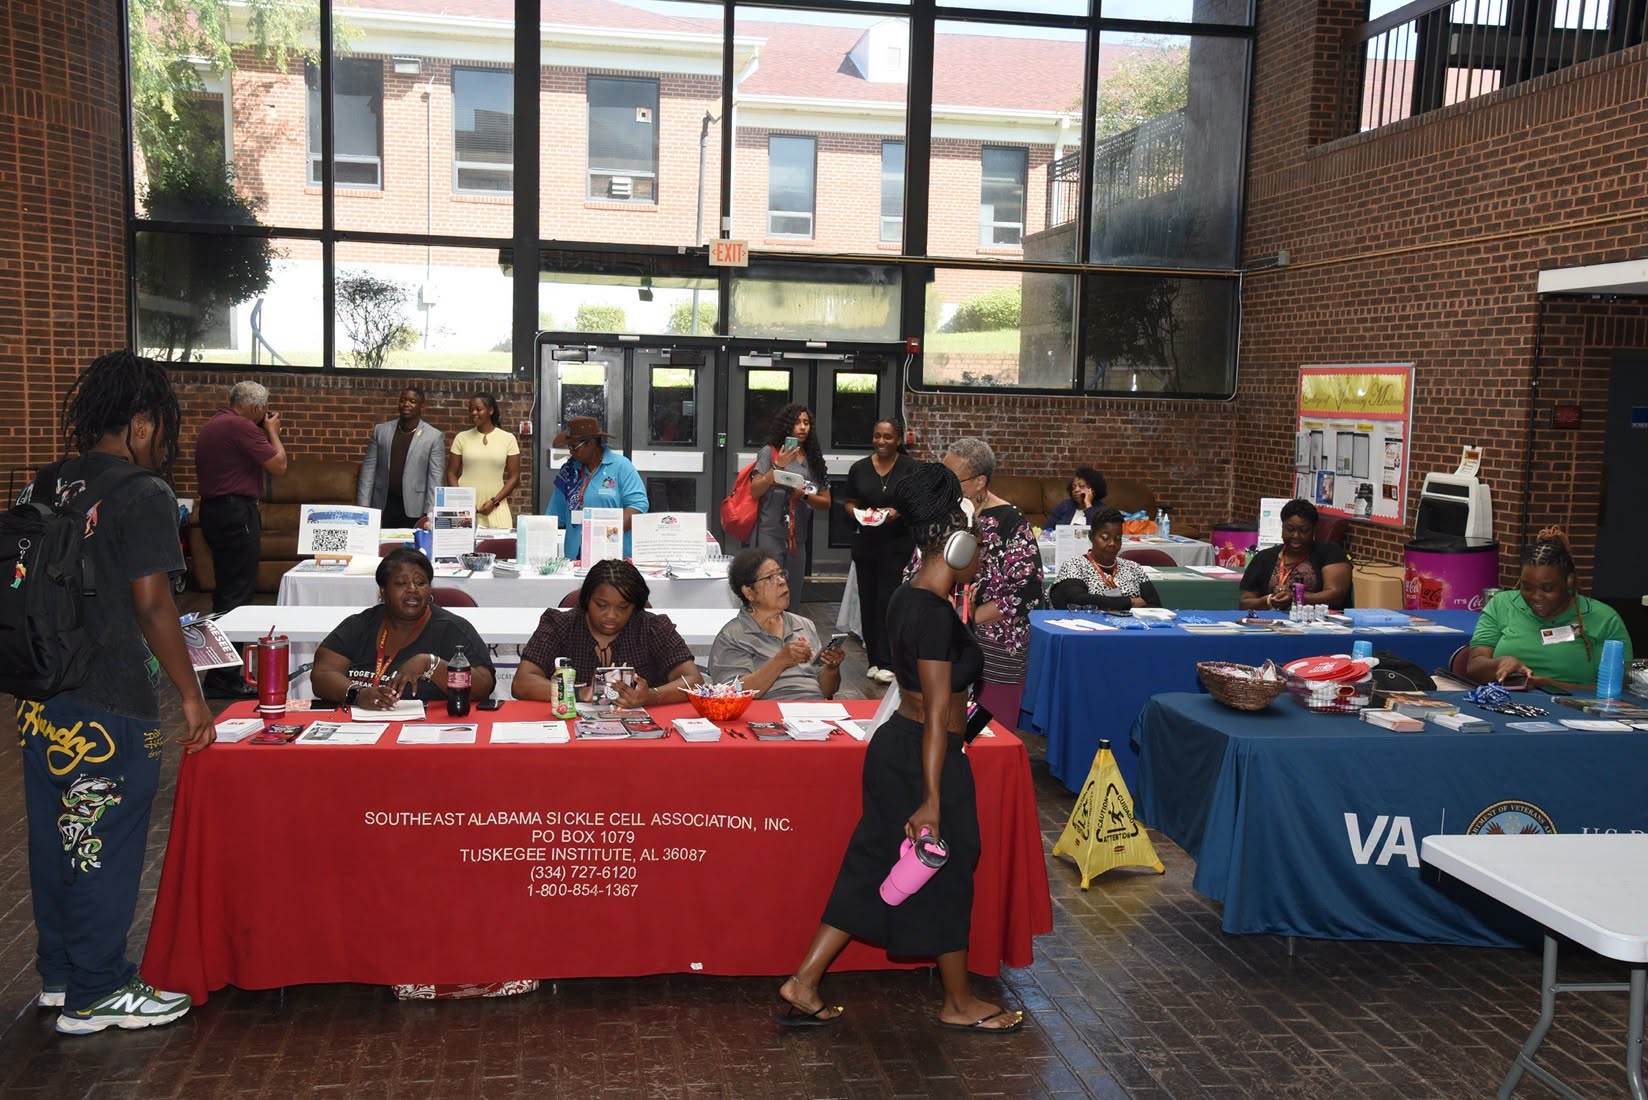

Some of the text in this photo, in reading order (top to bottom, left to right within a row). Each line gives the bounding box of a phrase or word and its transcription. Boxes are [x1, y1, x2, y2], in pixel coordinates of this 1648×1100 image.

[716, 242, 743, 263] EXIT
[348, 670, 390, 682] TOGETER
[1097, 796, 1109, 829] CAUTION
[1117, 794, 1135, 824] CUIDADO
[1471, 809, 1498, 834] RTMENT
[1498, 804, 1508, 812] OF
[1510, 803, 1547, 825] VETERANS
[363, 811, 793, 832] SOUTHEAST ALABAMA SICKLE CELL ASSOCIATION, INC.
[532, 829, 635, 844] PO BOX 1079
[1103, 831, 1132, 843] ATTENTION
[1344, 812, 1420, 868] VA
[460, 847, 707, 863] TUSKEGEE INSTITUTE, AL 36087
[530, 865, 637, 883] (334) 727-6120
[527, 883, 639, 897] 1-800-854-1367
[110, 992, 148, 1013] N
